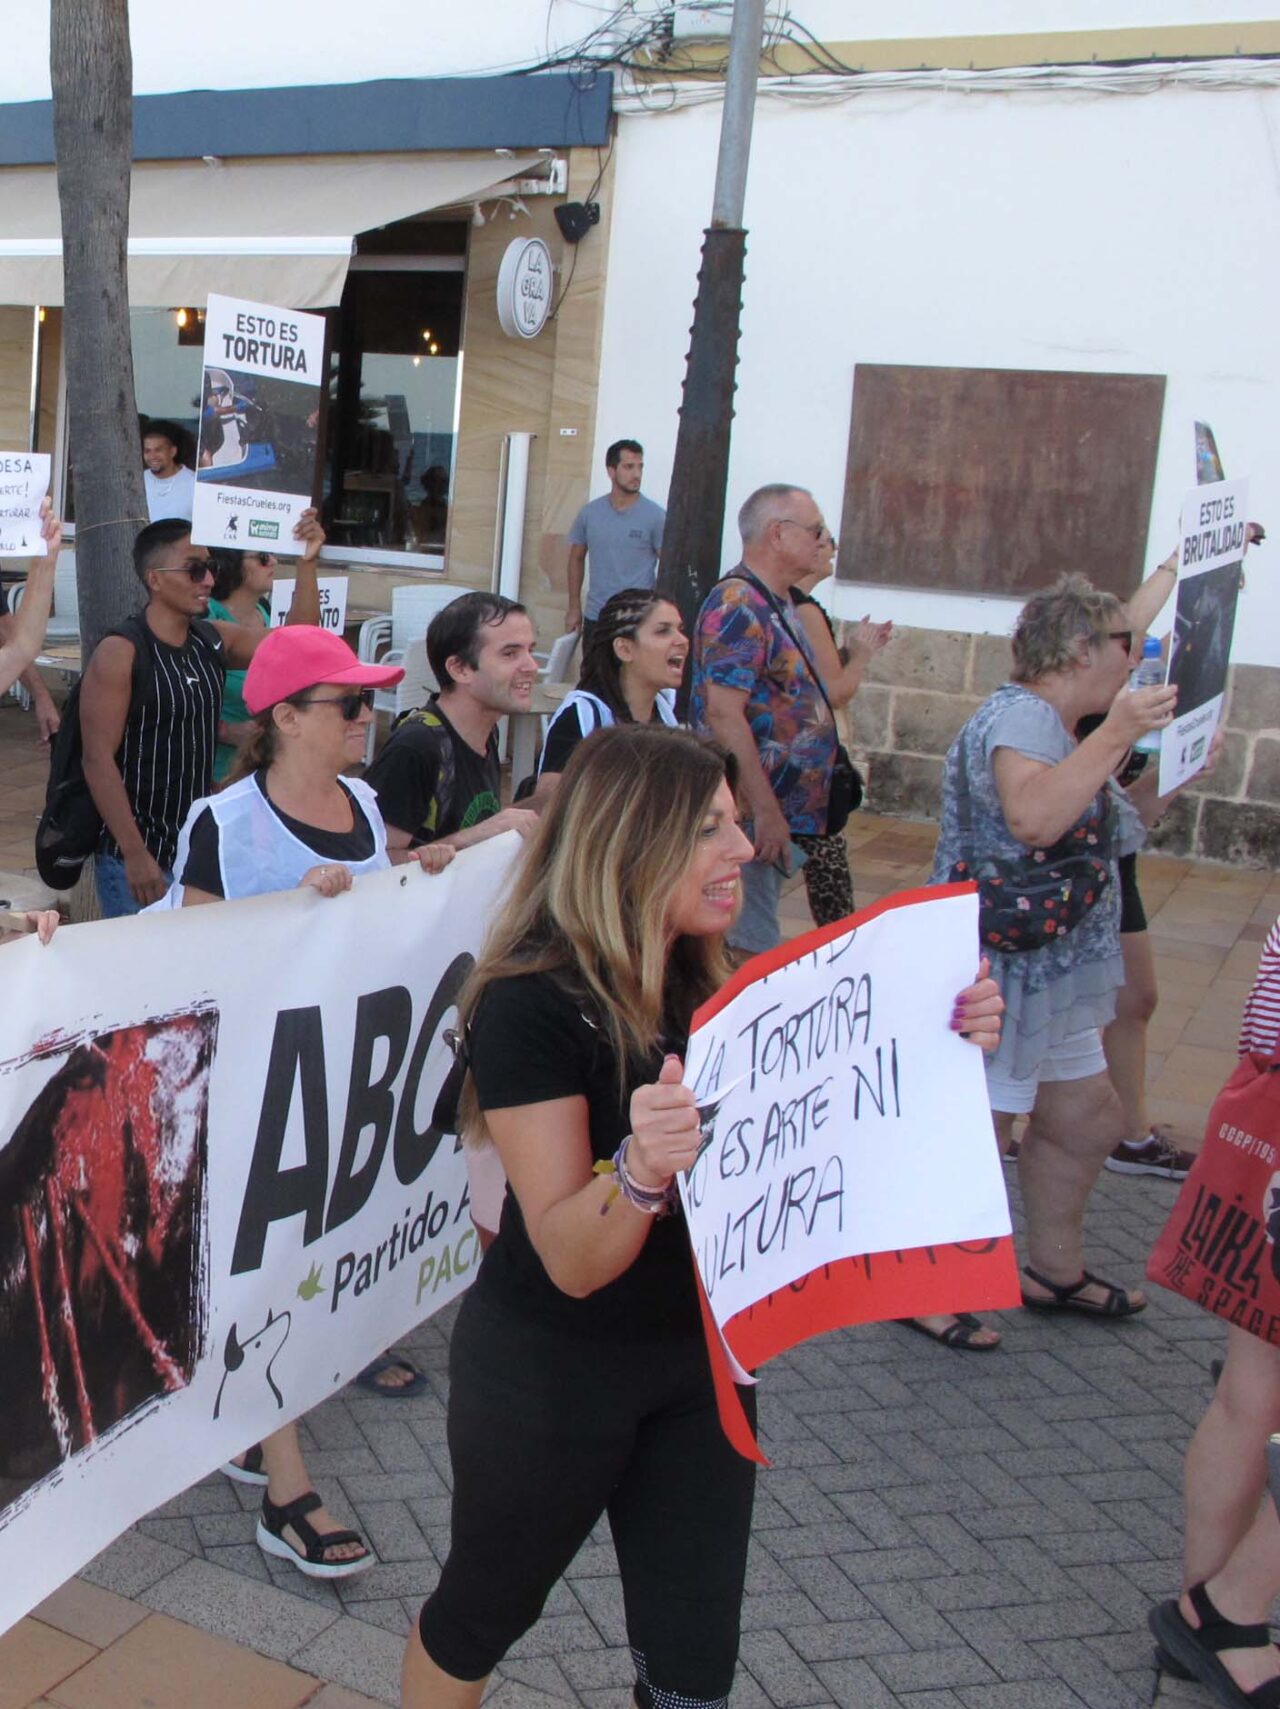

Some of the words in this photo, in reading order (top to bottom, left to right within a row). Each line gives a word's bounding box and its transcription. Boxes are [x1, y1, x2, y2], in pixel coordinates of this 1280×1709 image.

[528, 249, 542, 274] LA
[236, 313, 276, 339] ESTO
[280, 322, 299, 344] ES
[222, 333, 308, 374] TORTURA
[217, 492, 292, 515] FiestasCrueles.org
[1200, 499, 1222, 526] ESTO
[1223, 495, 1235, 520] ES
[1183, 521, 1244, 566] BRUTALIDAD
[737, 973, 871, 1092] TORTURA
[230, 950, 475, 1277] ABO
[719, 1117, 754, 1180] ES
[756, 1076, 834, 1174] ARTE
[851, 1038, 901, 1120] NI
[696, 1155, 844, 1300] ULTURA
[331, 1190, 448, 1313] Partido
